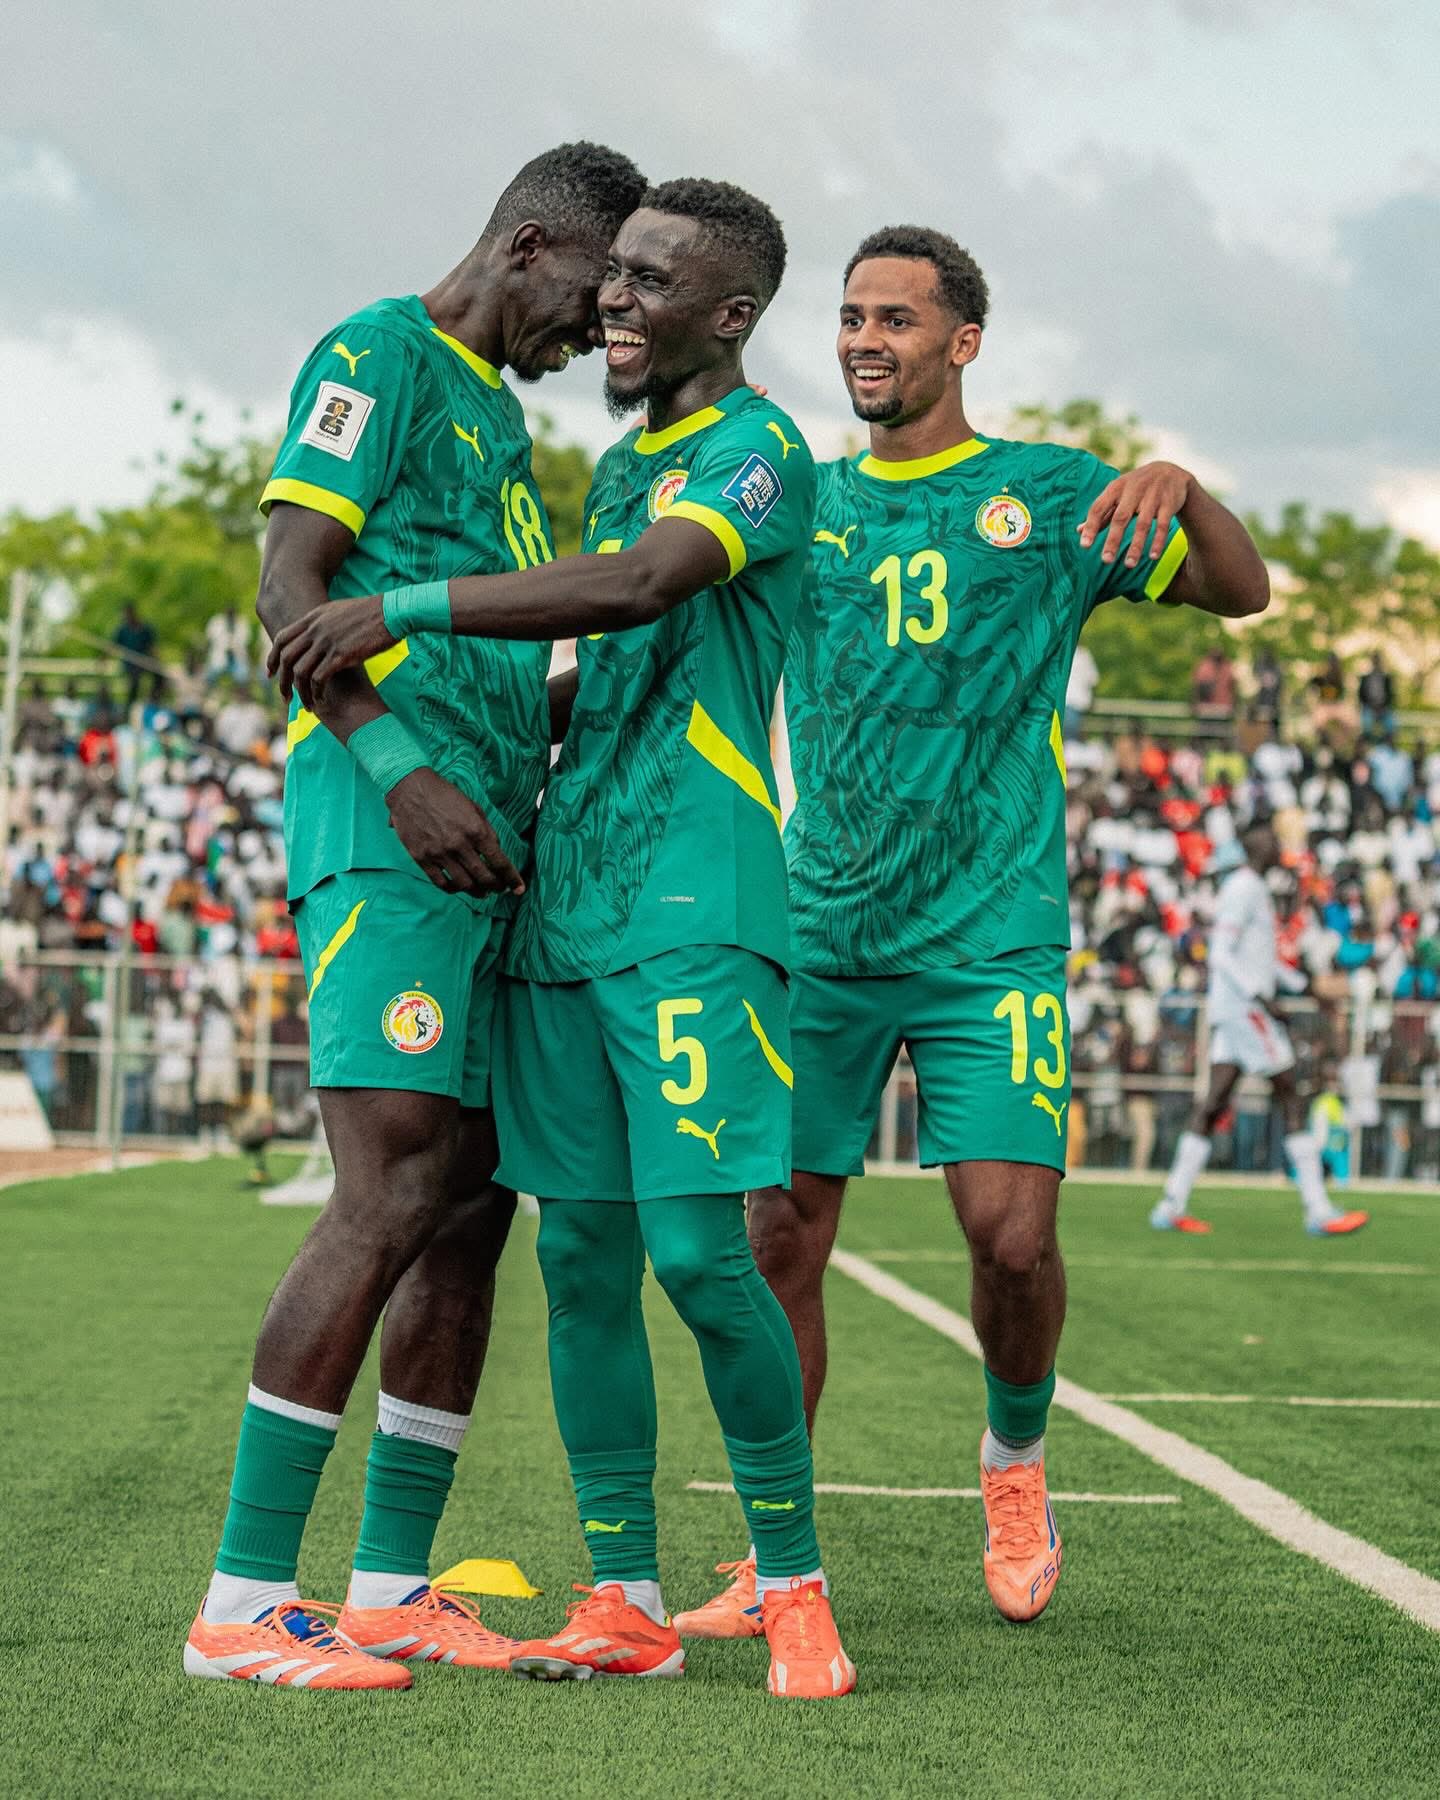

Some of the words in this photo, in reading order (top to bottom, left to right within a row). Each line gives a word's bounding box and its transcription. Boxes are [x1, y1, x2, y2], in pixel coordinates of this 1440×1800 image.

[501, 477, 552, 571] 18
[749, 470, 770, 501] UNITES
[754, 464, 775, 495] FOOTBALL
[870, 549, 949, 647] 13
[657, 998, 708, 1105] 5
[993, 990, 1066, 1088] 13
